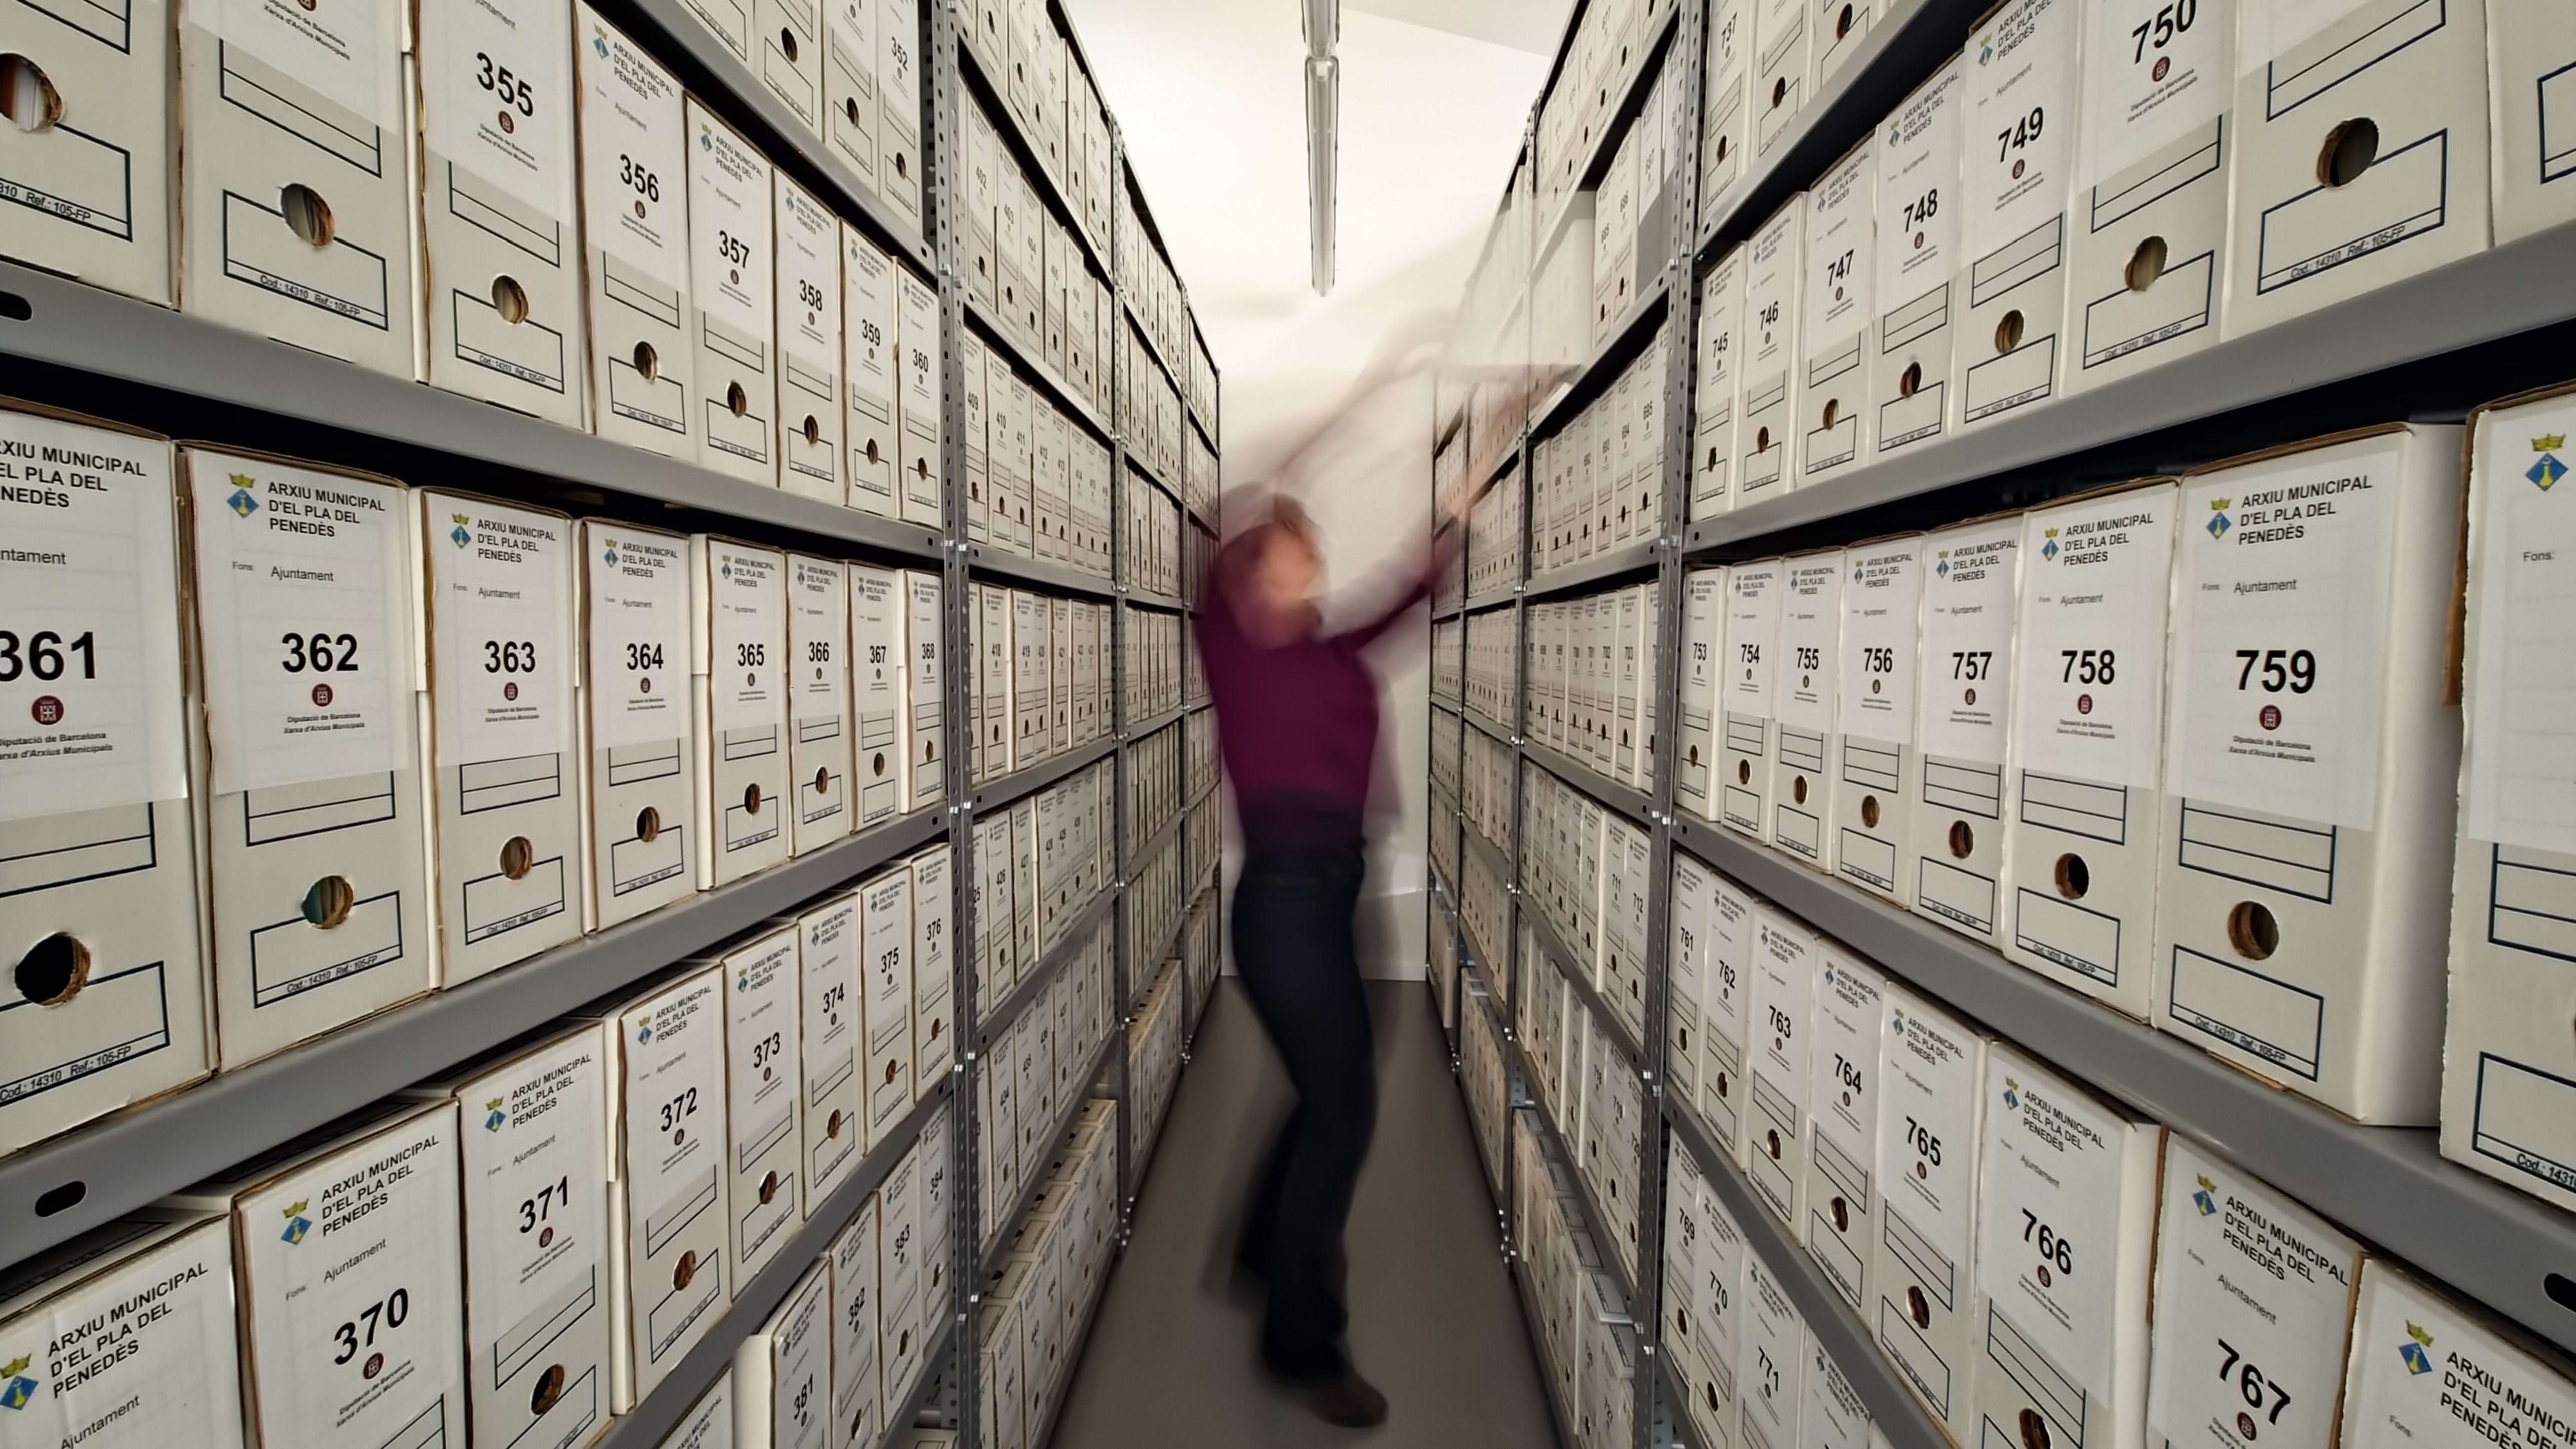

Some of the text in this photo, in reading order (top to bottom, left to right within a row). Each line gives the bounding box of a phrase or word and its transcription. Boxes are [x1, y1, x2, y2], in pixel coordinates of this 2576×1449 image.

[2132, 0, 2196, 64] 750
[613, 41, 674, 97] ARXIU MUNICIPAL
[891, 36, 908, 71] 352
[476, 52, 534, 117] 355
[614, 54, 661, 98] D'EL PLA DEL
[614, 66, 648, 100] PENEDÈS
[1998, 106, 2043, 163] 749
[620, 154, 659, 203] 356
[975, 166, 987, 189] 402
[1003, 203, 1015, 225] 403
[1904, 189, 1938, 233] 748
[719, 230, 750, 269] 357
[2315, 249, 2341, 269] 14310
[2371, 225, 2405, 247] 105-FP
[1828, 249, 1854, 287] 747
[799, 279, 822, 312] 358
[862, 318, 880, 346] 359
[1760, 300, 1779, 331] 746
[912, 348, 929, 373] 360
[1713, 331, 1728, 358] 745
[967, 392, 979, 411] 409
[996, 411, 1007, 429] 410
[1016, 430, 1026, 447] 411
[1039, 444, 1048, 460] 412
[43, 447, 147, 477] MUNICIPAL
[25, 468, 108, 492] PLA DEL
[268, 480, 385, 511] ARXIU MUNICIPAL
[2241, 475, 2372, 509] ARXIU MUNICIPAL
[269, 499, 360, 524] D'EL PLA DEL
[270, 517, 335, 538] PENEDÈS
[2066, 513, 2154, 537] ARXIU MUNICIPAL
[2240, 502, 2336, 527] D'EL PLA DEL
[477, 518, 556, 542] ARXIU MUNICIPAL
[478, 533, 538, 553] D'EL PLA DEL
[2065, 533, 2130, 552] D'EL PLA DEL
[2239, 524, 2304, 545] PENEDÈS
[478, 547, 522, 564] PENEDÈS
[2063, 550, 2108, 567] PENEDÈS
[2523, 550, 2555, 563] Fons:
[270, 566, 334, 582] Ajuntament
[2233, 578, 2298, 595] Ajuntament
[478, 586, 520, 601] Ajuntament
[2060, 593, 2103, 607] Ajuntament
[0, 631, 96, 682] 361
[281, 632, 359, 673] 362
[484, 640, 536, 674] 363
[626, 643, 664, 670] 364
[737, 643, 765, 668] 365
[808, 641, 829, 663] 366
[869, 645, 886, 664] 367
[922, 643, 935, 660] 368
[992, 643, 1001, 658] 418
[1693, 643, 1707, 661] 753
[1741, 644, 1760, 664] 754
[1797, 647, 1819, 670] 755
[1864, 648, 1893, 674] 756
[1952, 651, 1993, 680] 757
[2061, 649, 2116, 685] 758
[2236, 649, 2316, 695] 759
[59, 732, 106, 742] Barcelona
[63, 744, 113, 754] Municipals
[996, 869, 1005, 886] 426
[1611, 873, 1621, 892] 711
[1633, 892, 1643, 914] 712
[927, 918, 942, 940] 376
[1680, 926, 1694, 952] 761
[881, 947, 899, 974] 375
[1719, 960, 1736, 990] 762
[823, 982, 844, 1013] 374
[1769, 1005, 1792, 1039] 763
[753, 1032, 781, 1068] 373
[30, 1070, 62, 1091] 14310
[96, 1046, 131, 1067] 105-FP
[511, 1054, 592, 1101] ARXIU MUNICIPAL
[1835, 1054, 1862, 1095] 764
[512, 1075, 574, 1115] D'EL PLA DEL
[661, 1086, 697, 1133] 372
[513, 1097, 558, 1128] PENEDÈS
[2023, 1103, 2084, 1151] D'EL PLA DEL
[2024, 1090, 2105, 1150] ARXIU MUNICIPAL
[513, 1133, 556, 1166] Ajuntament
[1905, 1115, 1942, 1168] 765
[2023, 1117, 2065, 1153] PENEDÈS
[322, 1135, 439, 1203] ARXIU MUNICIPAL
[2020, 1154, 2060, 1189] Ajuntament
[2517, 1153, 2544, 1174] Cod.:
[322, 1164, 413, 1220] D'EL PLA DEL
[519, 1175, 568, 1235] 371
[323, 1193, 388, 1236] PENEDÈS
[1678, 1206, 1696, 1240] 769
[2022, 1208, 2072, 1276] 766
[2222, 1230, 2286, 1282] PENEDÈS
[2225, 1211, 2315, 1284] D'EL PLA DEL
[2226, 1195, 2349, 1286] ARXIU MUNICIPAL
[323, 1238, 386, 1283] Ajuntament
[1709, 1270, 1728, 1310] 770
[2217, 1273, 2277, 1326] Ajuntament
[47, 1262, 209, 1358] ARXIU MUNICIPAL
[849, 1287, 866, 1327] 382
[50, 1302, 173, 1378] D'EL PLA DEL
[333, 1288, 409, 1367] 370
[52, 1339, 139, 1399] PENEDÈS
[1758, 1345, 1779, 1392] 771
[2217, 1338, 2291, 1426] 767
[2447, 1351, 2502, 1395] ARXIU
[794, 1372, 813, 1420] 381
[2444, 1370, 2521, 1436] D'EL PLA
